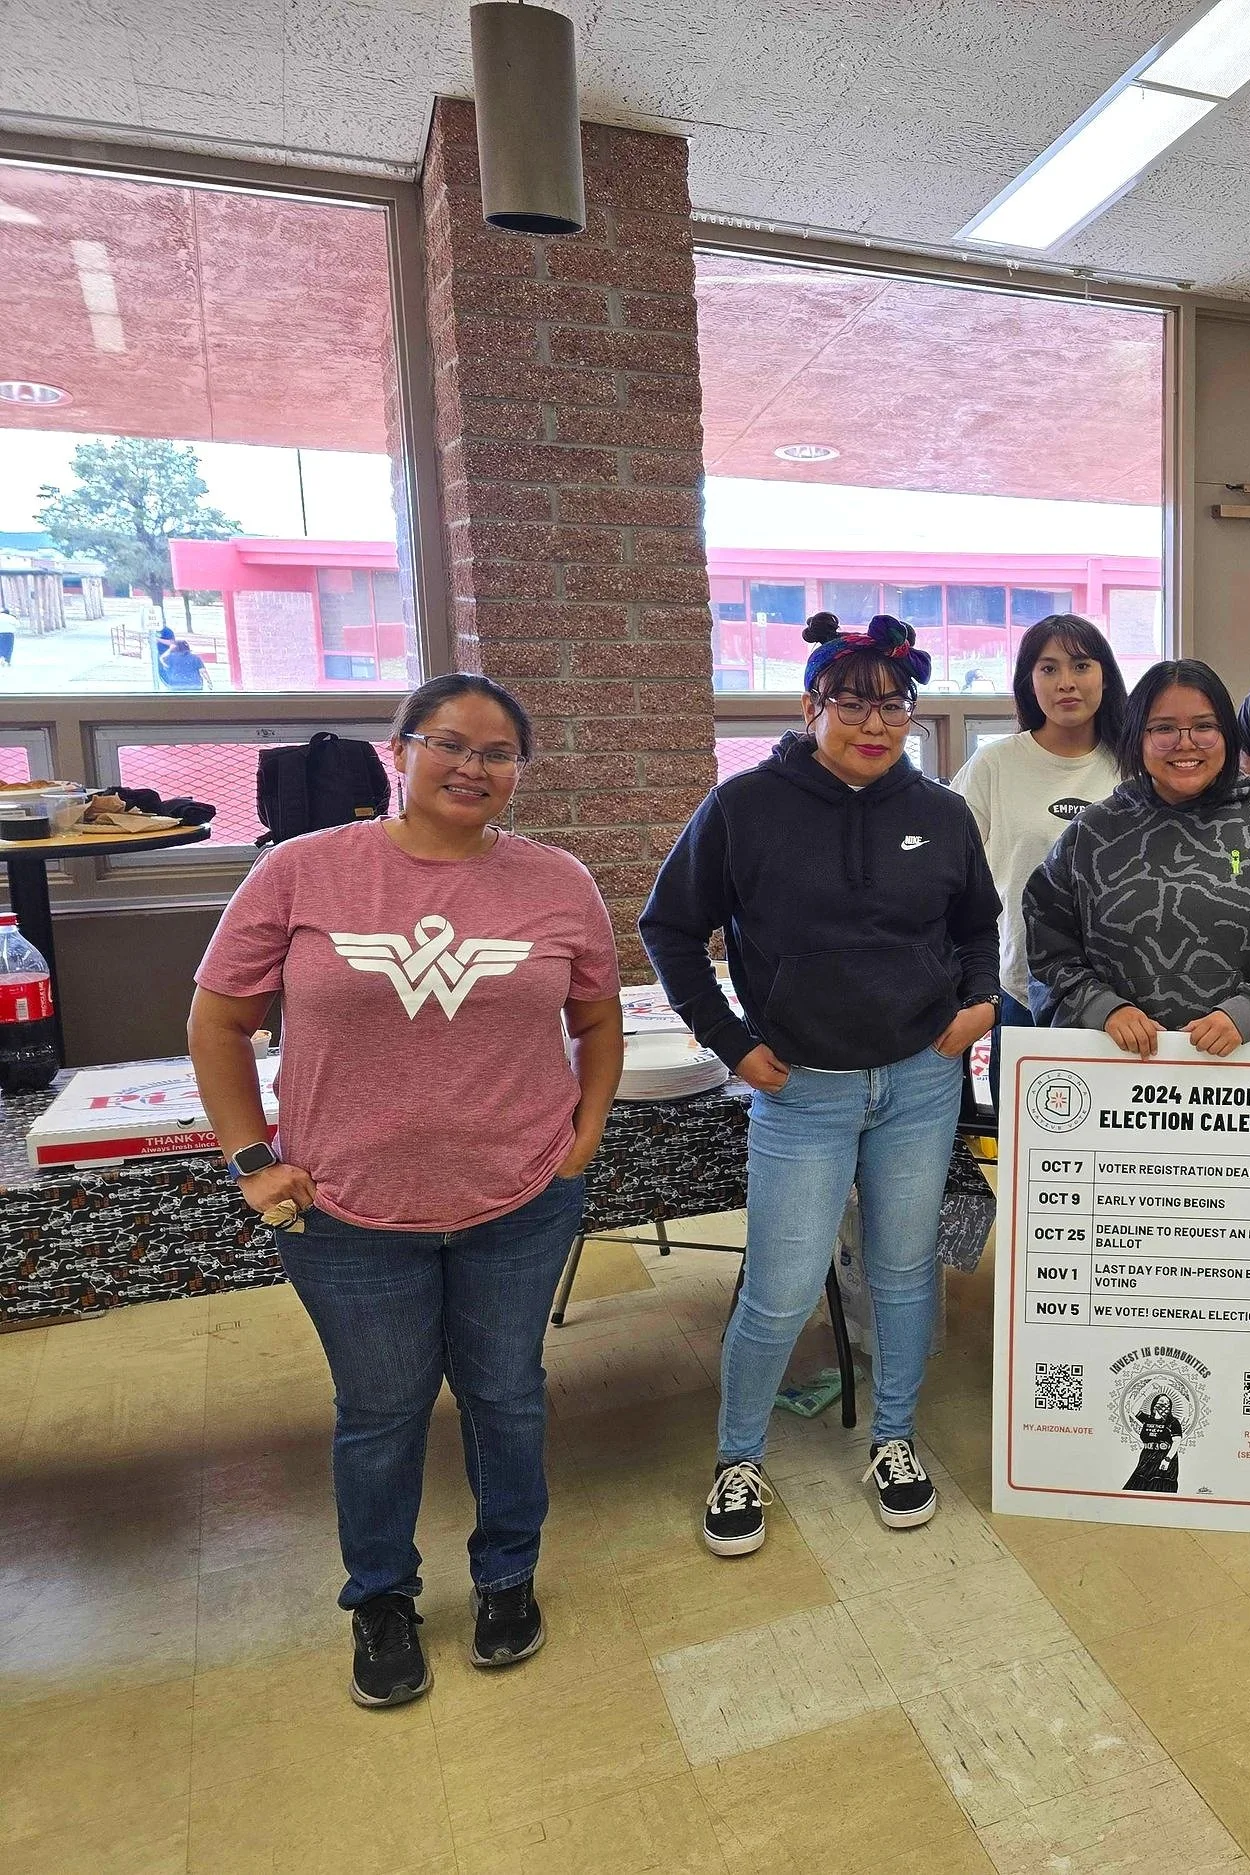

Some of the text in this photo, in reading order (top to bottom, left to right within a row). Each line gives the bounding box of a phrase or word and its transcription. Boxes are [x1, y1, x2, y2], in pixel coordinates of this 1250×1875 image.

[905, 835, 923, 845] NIKE
[1131, 1084, 1183, 1105] 2024
[1099, 1110, 1194, 1131] ELECTION
[145, 1132, 215, 1147] THANK YO
[140, 1141, 216, 1154] Always fresh since
[1041, 1160, 1083, 1174] OCT 7
[1098, 1163, 1136, 1174] VOTER
[1139, 1164, 1223, 1177] REGISTRATION
[1038, 1192, 1081, 1205] OCT 9
[1097, 1195, 1226, 1209] EARLY VOTING BEGINS
[1034, 1227, 1086, 1241] OCT 25
[1096, 1224, 1154, 1237] DEADLINE
[1157, 1226, 1171, 1237] TO
[1174, 1226, 1227, 1239] REQUEST
[1229, 1228, 1246, 1239] AN
[1095, 1238, 1142, 1249] BALLOT
[1037, 1267, 1078, 1280] NOV 1
[1095, 1263, 1126, 1275] LAST
[1128, 1264, 1153, 1276] DAY
[1155, 1266, 1177, 1276] FOR
[1180, 1266, 1243, 1279] IN-PERSON
[1094, 1277, 1137, 1288] VOTING
[1036, 1302, 1080, 1315] NOV 5
[1094, 1305, 1112, 1316] WE
[1114, 1306, 1149, 1318] VOTE!
[1151, 1308, 1206, 1320] GENERAL
[1109, 1346, 1212, 1379] INVEST IN COMMUNITIES
[1023, 1423, 1094, 1435] MY.ARIZONA.VOTE
